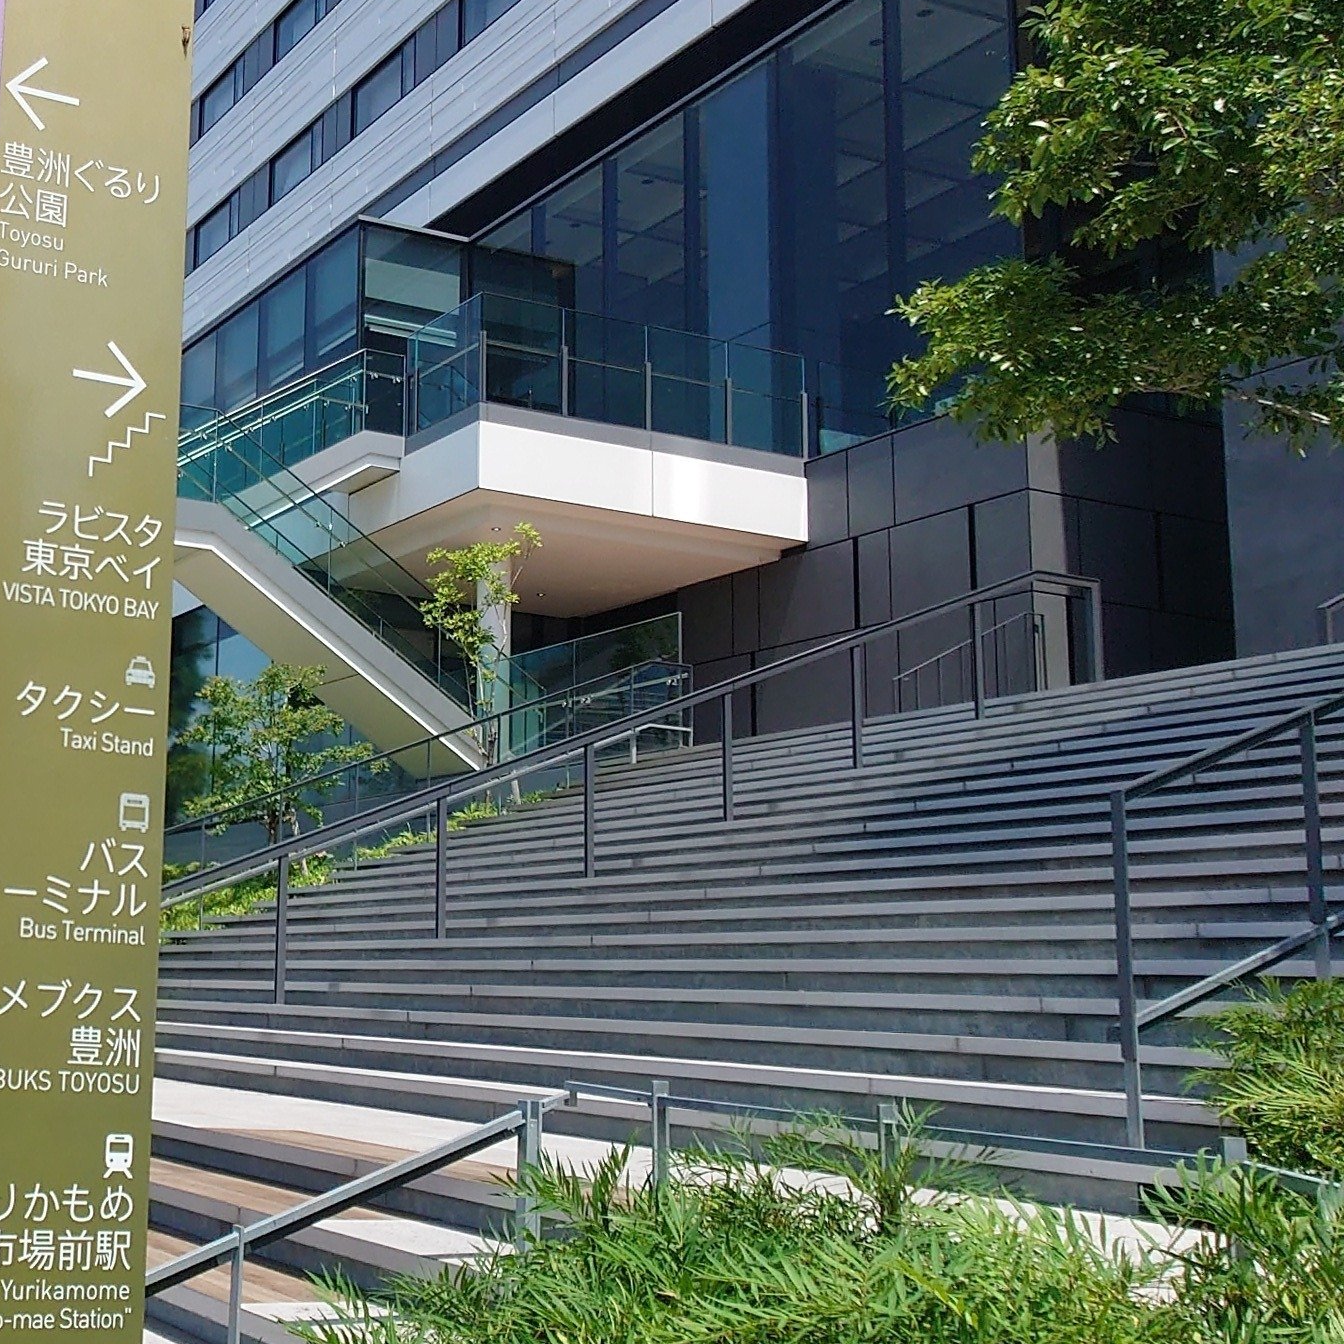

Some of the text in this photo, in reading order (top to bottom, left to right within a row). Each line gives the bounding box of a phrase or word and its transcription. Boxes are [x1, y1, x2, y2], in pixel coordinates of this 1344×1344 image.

[0, 140, 161, 205] 豊洲ぐるり
[64, 262, 108, 287] Park
[38, 500, 163, 548] ラビスタ
[20, 538, 161, 590] 東京ベイ
[2, 580, 56, 607] VISTA
[58, 587, 120, 615] TOKYO
[123, 597, 160, 620] BAY
[16, 680, 156, 724] タクシー
[59, 726, 154, 757] Taxi Stand
[79, 837, 149, 879] バス
[19, 917, 146, 946] Bus Terminal
[66, 1024, 141, 1069] 豊洲
[57, 1070, 141, 1095] TOYOSU
[0, 1278, 131, 1302] Yurikamome
[59, 1306, 132, 1330] Station"
